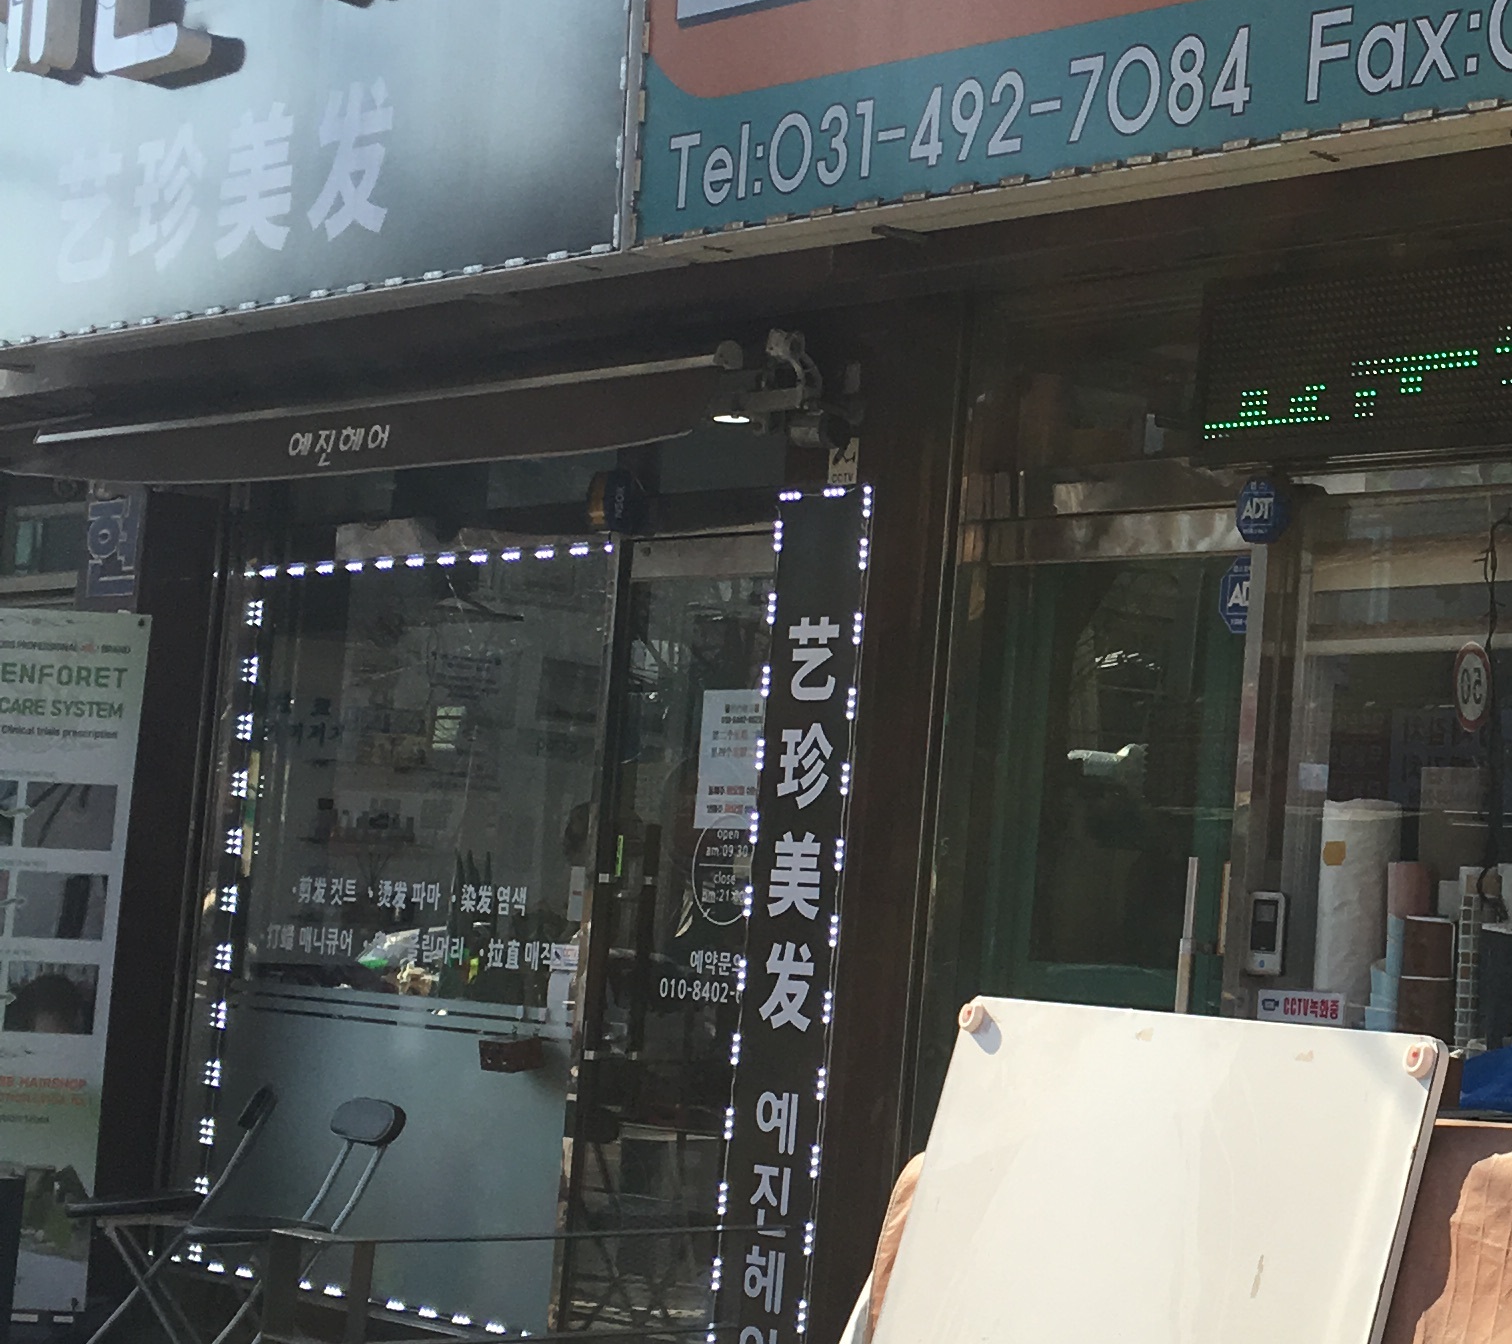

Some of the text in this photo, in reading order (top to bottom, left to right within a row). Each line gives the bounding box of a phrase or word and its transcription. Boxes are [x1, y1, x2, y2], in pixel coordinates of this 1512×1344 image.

[669, 23, 1253, 212] Tel:031-492-7084
[54, 76, 396, 284] 艺珍美发
[288, 423, 391, 467] 예진헤어
[1240, 496, 1274, 521] ADT
[0, 696, 124, 719] CARE SYSTEM
[716, 829, 740, 841] open
[758, 615, 841, 1033] 艺珍美发
[713, 870, 736, 885] close
[411, 881, 441, 911] 파마
[460, 884, 492, 915] 染发
[497, 885, 528, 917] 염색
[298, 925, 353, 957] 매니큐어
